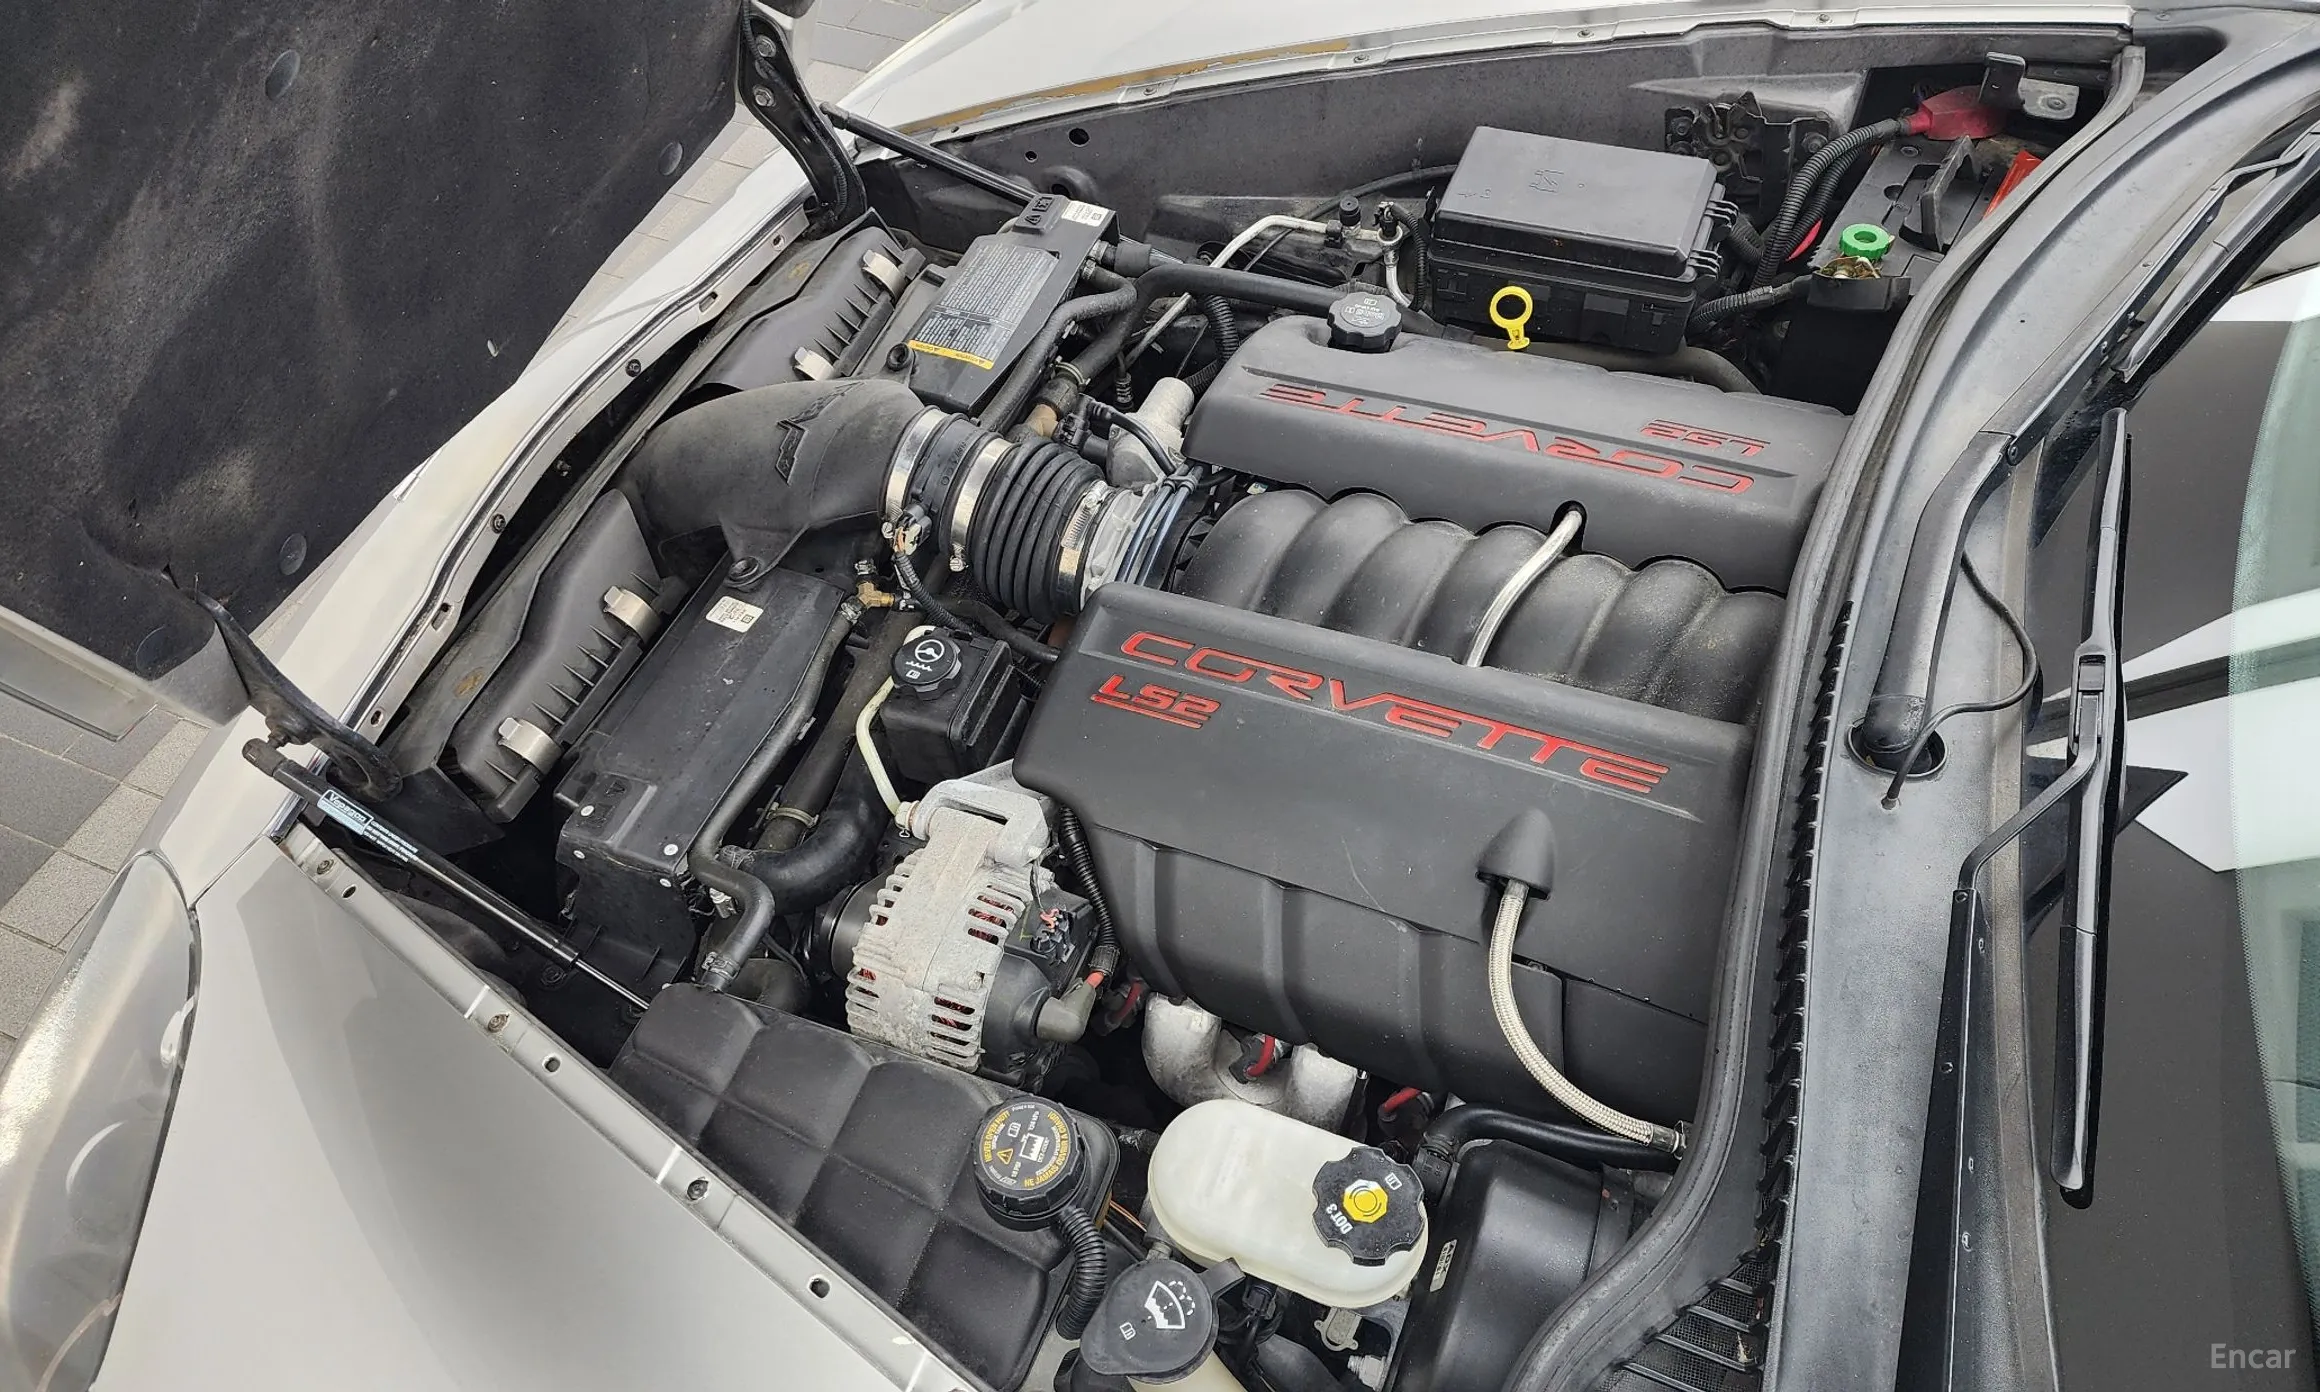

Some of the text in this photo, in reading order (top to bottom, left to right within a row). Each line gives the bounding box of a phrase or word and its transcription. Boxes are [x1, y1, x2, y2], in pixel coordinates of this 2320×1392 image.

[1258, 384, 1755, 494] CORVETTE
[1640, 420, 1768, 457] LS2
[1096, 674, 1222, 725] LS2
[1120, 630, 1670, 794] CORVETTE
[1326, 1203, 1353, 1234] DOT 3
